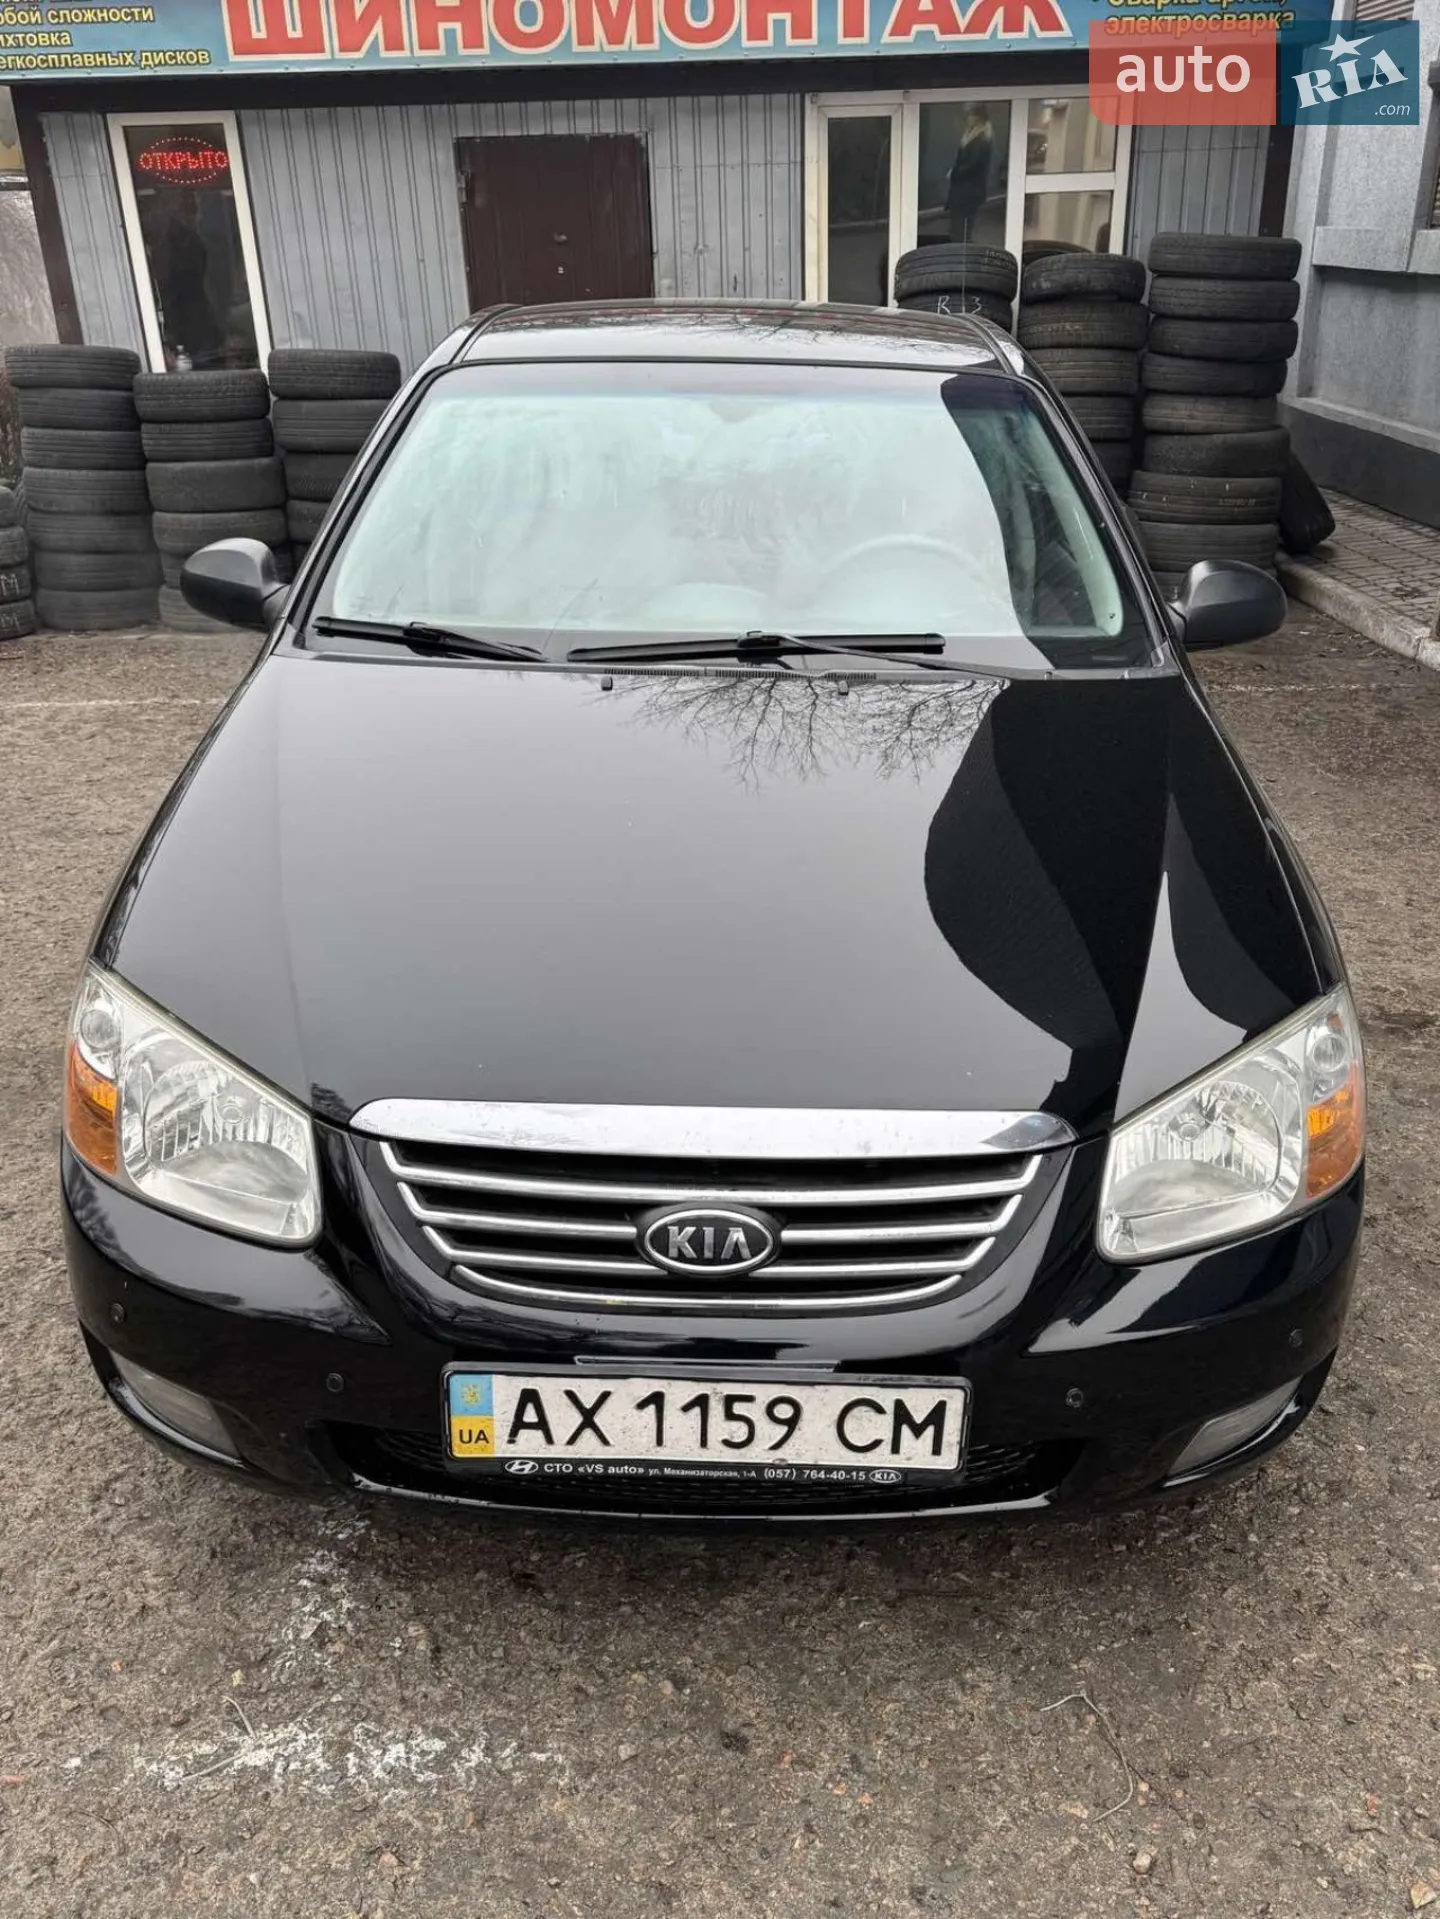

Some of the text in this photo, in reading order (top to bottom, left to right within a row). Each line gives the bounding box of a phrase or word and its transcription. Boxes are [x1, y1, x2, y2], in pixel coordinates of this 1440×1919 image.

[47, 7, 155, 24] сложности
[141, 50, 211, 69] дисков
[138, 150, 229, 170] ОТКРЫТО
[667, 1225, 752, 1260] KIA
[507, 1387, 948, 1457] AX 1159 CM
[458, 1428, 490, 1445] UA
[543, 1462, 574, 1474] СТО
[764, 1467, 797, 1481] (057)
[803, 1469, 867, 1482] 764-40-15
